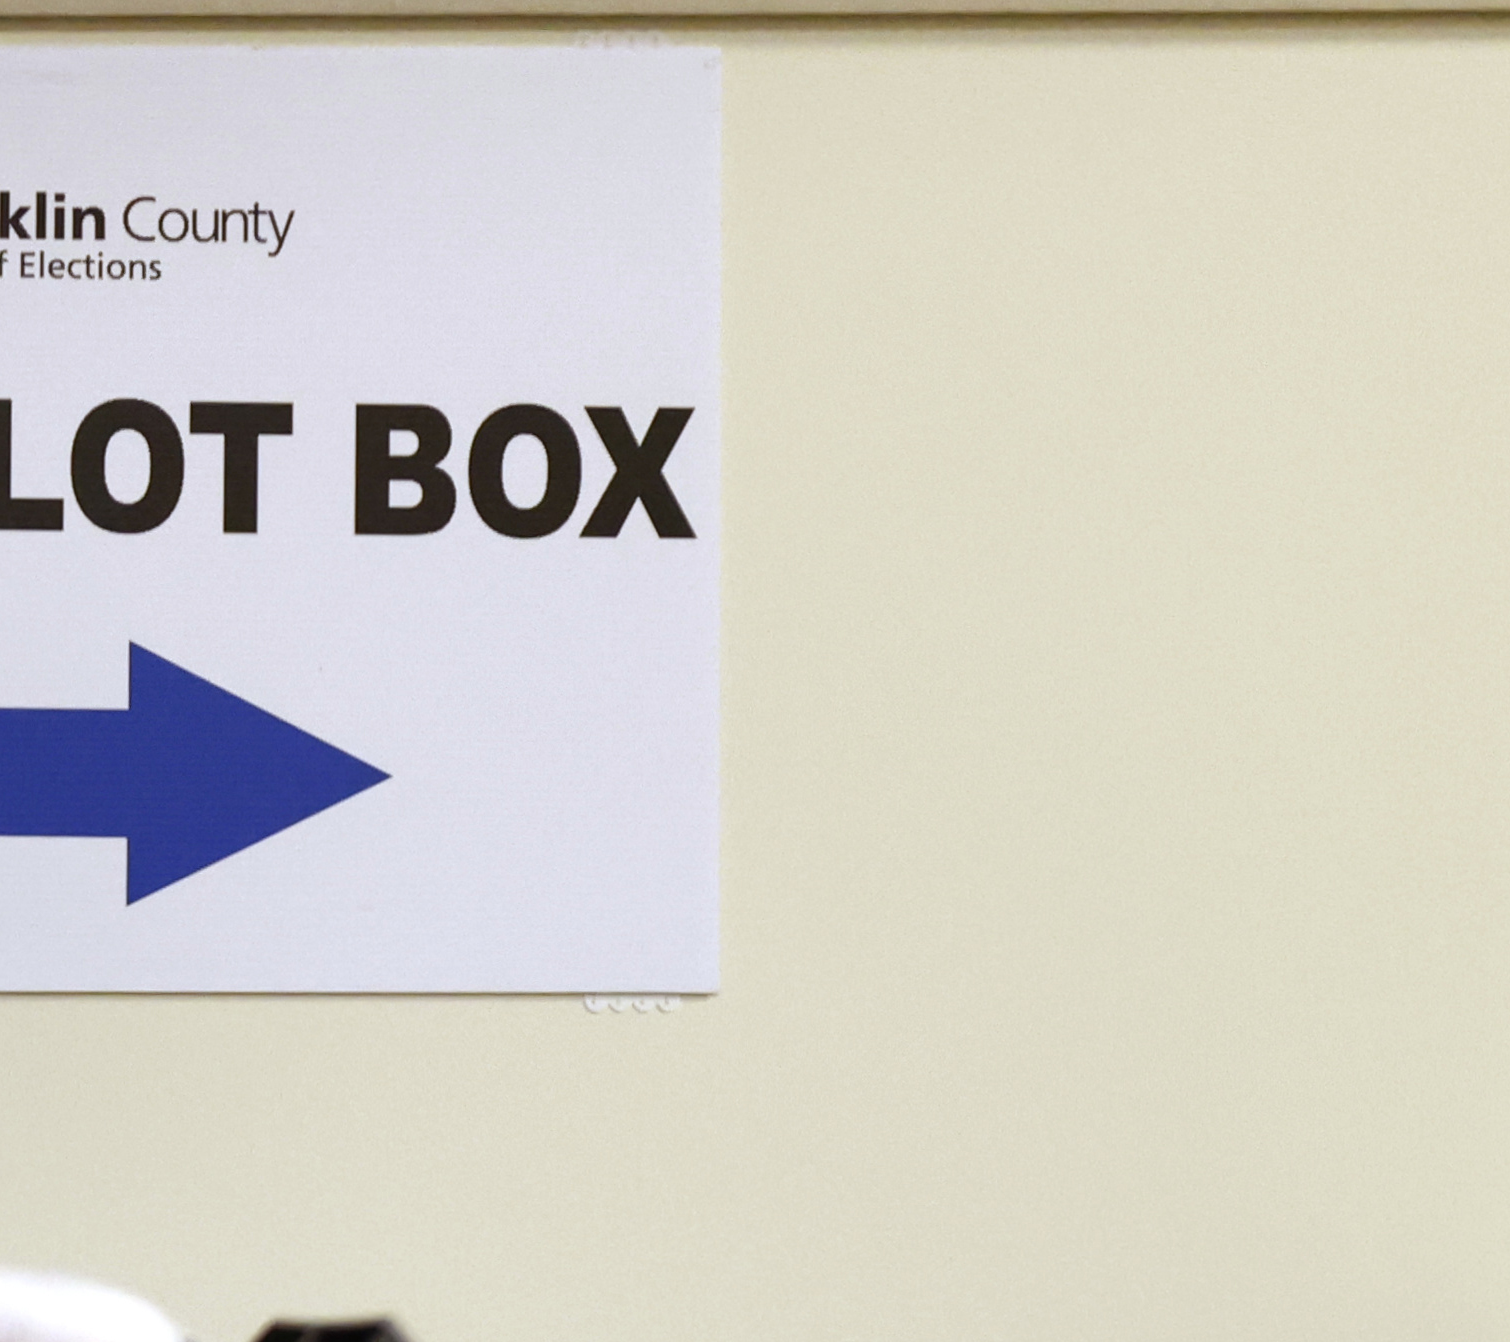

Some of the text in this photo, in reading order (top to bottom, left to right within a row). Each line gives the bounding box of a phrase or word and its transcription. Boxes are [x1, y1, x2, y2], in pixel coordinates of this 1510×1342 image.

[122, 195, 295, 257] County
[19, 250, 163, 281] Elections
[354, 403, 696, 540] BOX
